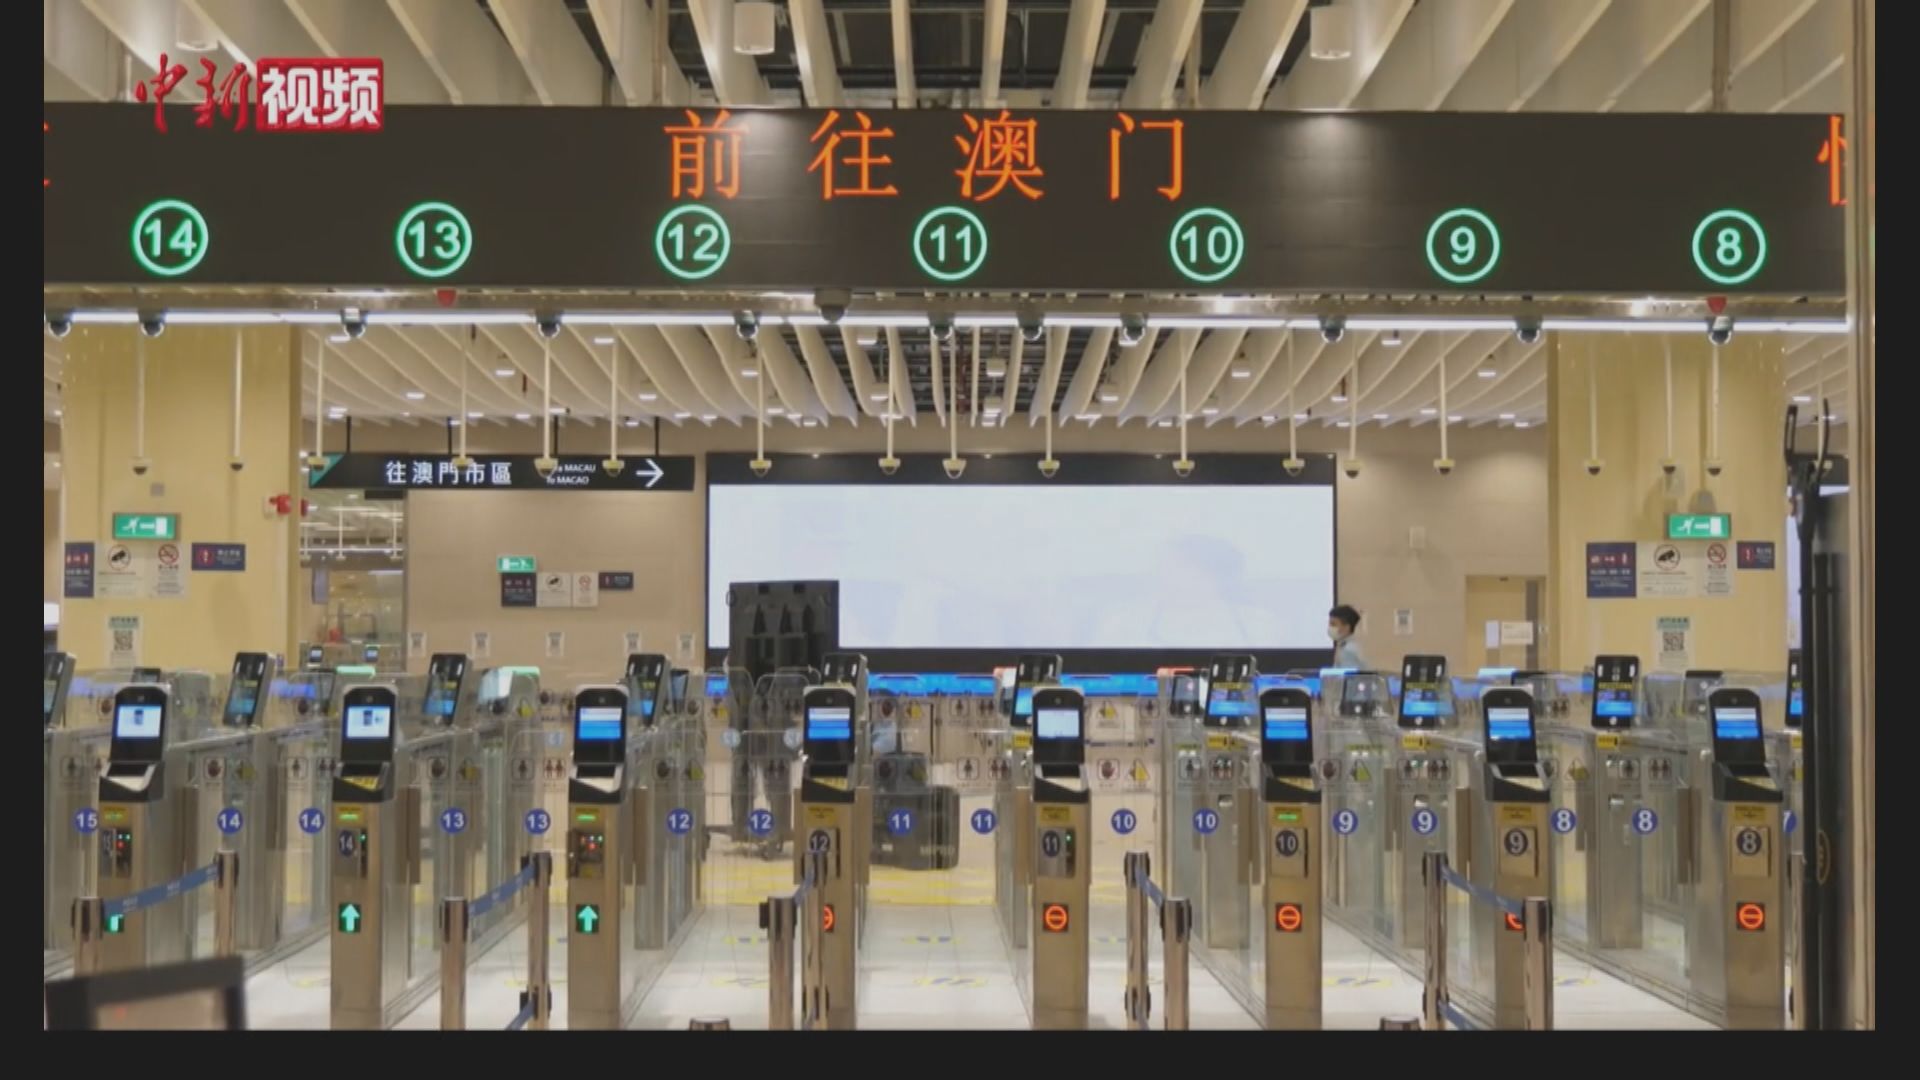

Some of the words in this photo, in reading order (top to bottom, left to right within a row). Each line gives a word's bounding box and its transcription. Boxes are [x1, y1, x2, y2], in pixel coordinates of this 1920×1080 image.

[663, 109, 1186, 201] 前往澳门
[143, 218, 198, 258] 14
[407, 219, 461, 260] 13
[665, 223, 720, 262] 12
[929, 224, 975, 263] 11
[1180, 224, 1234, 264] 10
[1449, 225, 1477, 266] 9
[1715, 227, 1743, 267] 8
[386, 460, 513, 485] 往澳門市區
[76, 813, 98, 829] 15
[219, 812, 241, 829] 14
[301, 812, 322, 829] 14
[443, 813, 465, 829] 13
[527, 813, 549, 830] 13
[668, 813, 690, 830] 12
[750, 813, 772, 830] 12
[891, 813, 911, 830] 11
[974, 813, 993, 830] 11
[1112, 813, 1135, 830] 10
[1196, 813, 1217, 830] 10
[1338, 811, 1354, 831] 9
[1417, 811, 1433, 831] 9
[1556, 810, 1572, 831] 8
[1637, 810, 1653, 831] 8
[339, 834, 353, 850] 14
[812, 835, 828, 851] 12
[1045, 836, 1058, 851] 11
[1277, 835, 1297, 851] 10
[1509, 832, 1524, 854] 9
[1742, 832, 1757, 854] 8
